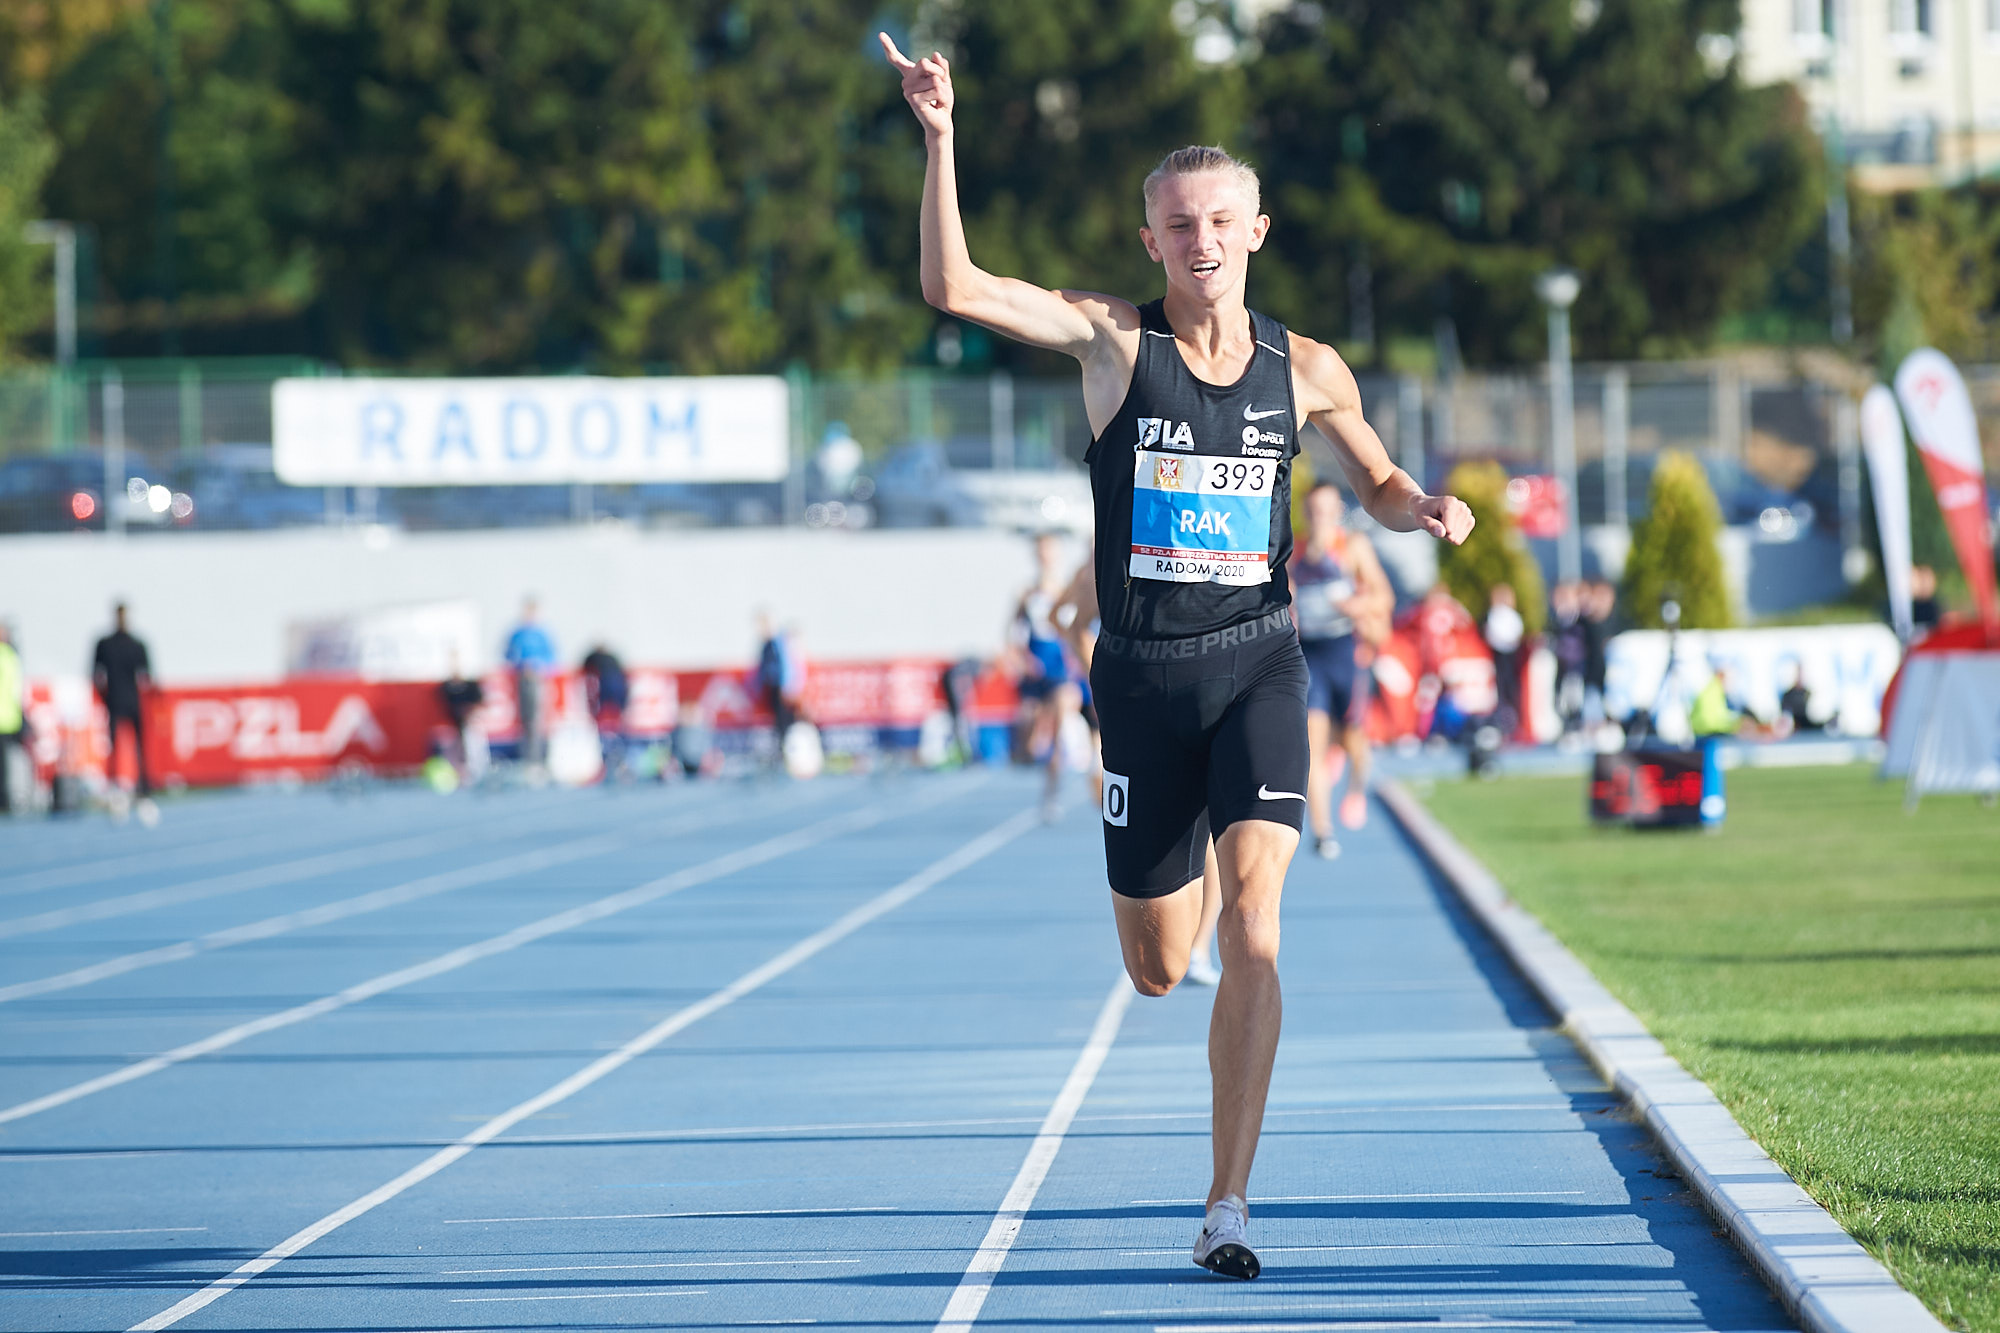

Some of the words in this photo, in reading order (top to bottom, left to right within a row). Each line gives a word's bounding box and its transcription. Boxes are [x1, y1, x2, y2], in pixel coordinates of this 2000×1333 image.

[359, 399, 704, 461] RADOM
[1211, 462, 1265, 491] 393
[1180, 509, 1232, 536] RAK
[1152, 548, 1171, 557] PZLA
[1156, 560, 1211, 575] RADOM
[1215, 565, 1245, 577] 2020
[1098, 630, 1127, 655] RO
[1130, 639, 1196, 659] NIKE
[1201, 619, 1258, 655] PRO
[172, 696, 388, 758] PZLA
